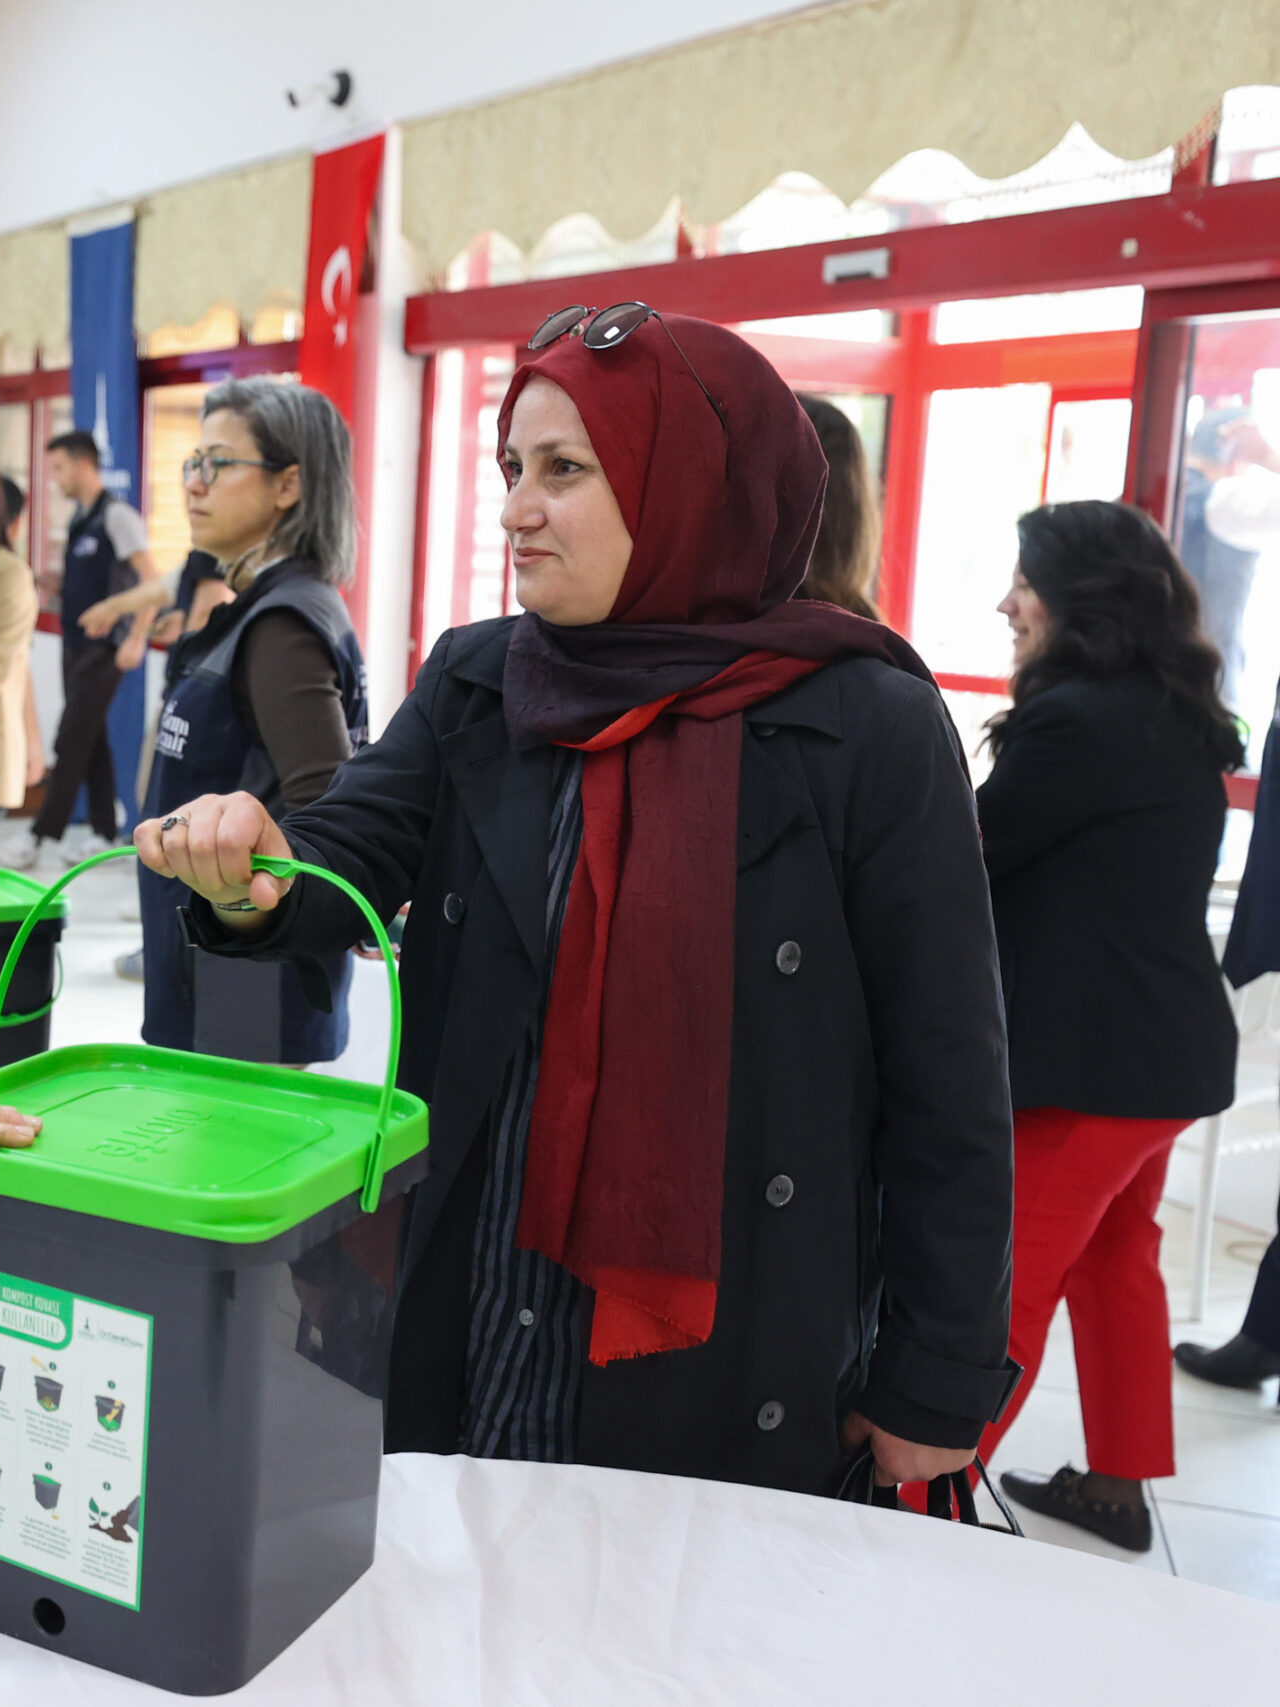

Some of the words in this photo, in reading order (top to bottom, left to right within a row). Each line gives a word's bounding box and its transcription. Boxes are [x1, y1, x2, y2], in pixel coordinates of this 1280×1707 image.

[2, 1286, 34, 1308] KOMPOST
[35, 1296, 60, 1316] KOVASI
[2, 1307, 60, 1339] KULLANILIR?
